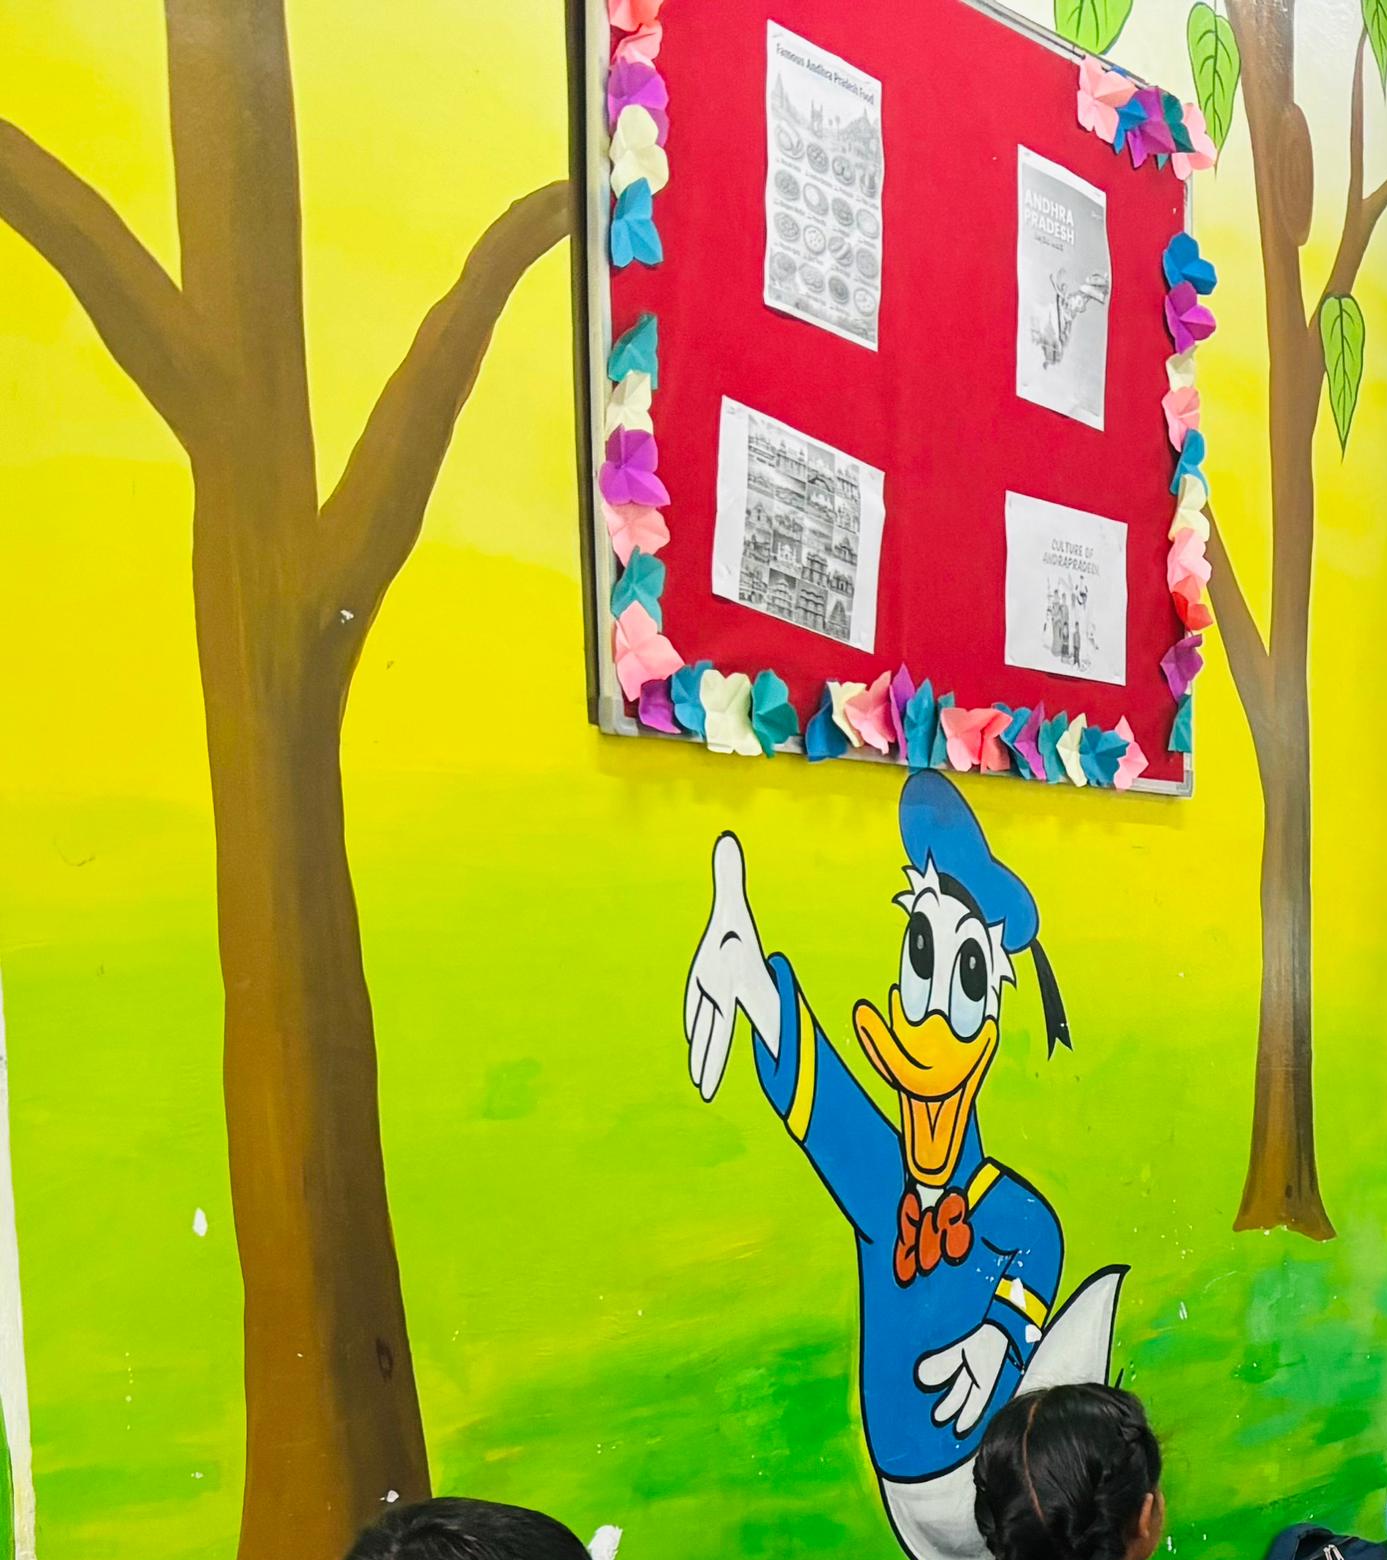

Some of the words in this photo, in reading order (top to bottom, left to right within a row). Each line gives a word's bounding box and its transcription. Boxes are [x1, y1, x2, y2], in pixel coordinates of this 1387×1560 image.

[1024, 188, 1074, 227] ANDHRA
[1024, 207, 1074, 245] PRADESH
[1052, 538, 1082, 557] CULTURE
